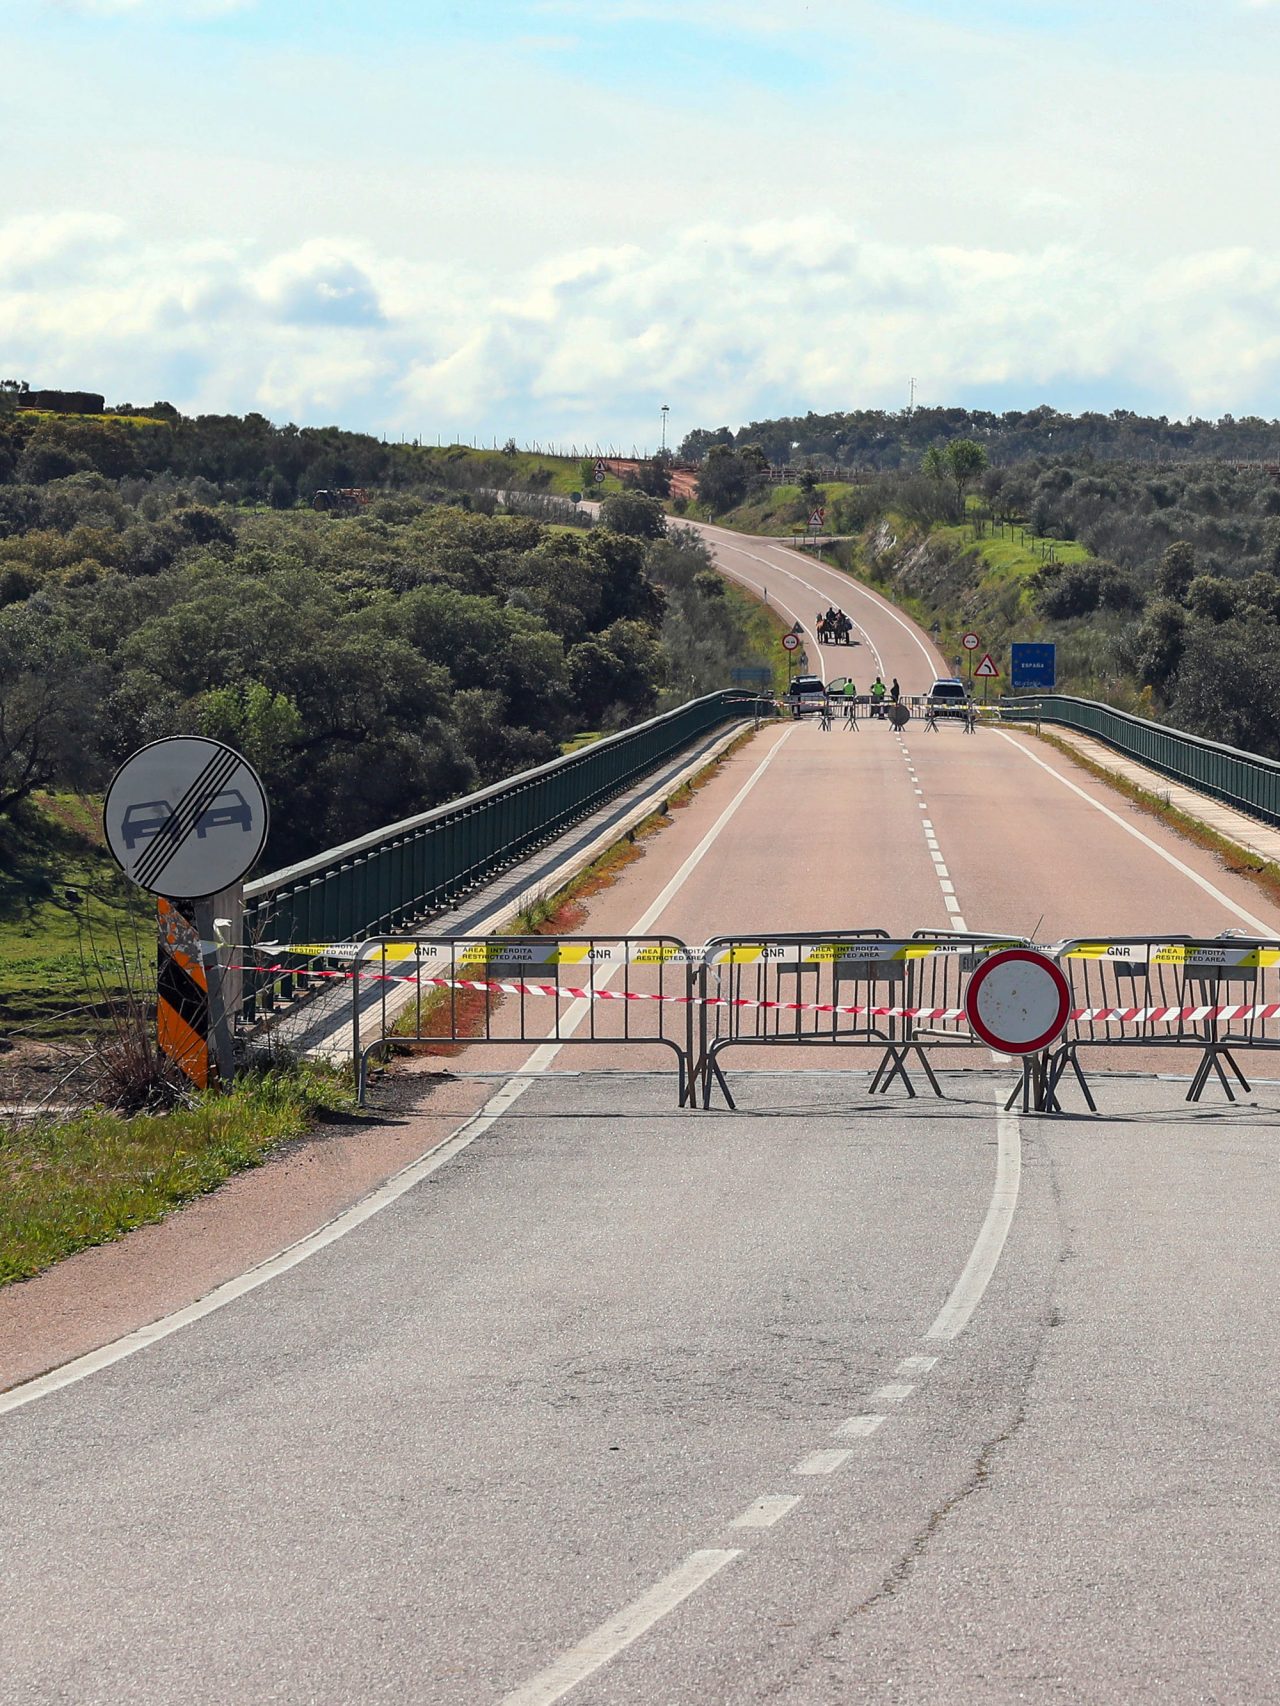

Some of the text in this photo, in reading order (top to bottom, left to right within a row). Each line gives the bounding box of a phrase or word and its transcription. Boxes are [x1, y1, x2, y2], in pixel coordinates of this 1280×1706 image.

[413, 947, 437, 957] GNR
[587, 949, 611, 959] GNR
[761, 948, 785, 958] GNR
[1107, 947, 1131, 957] GNR
